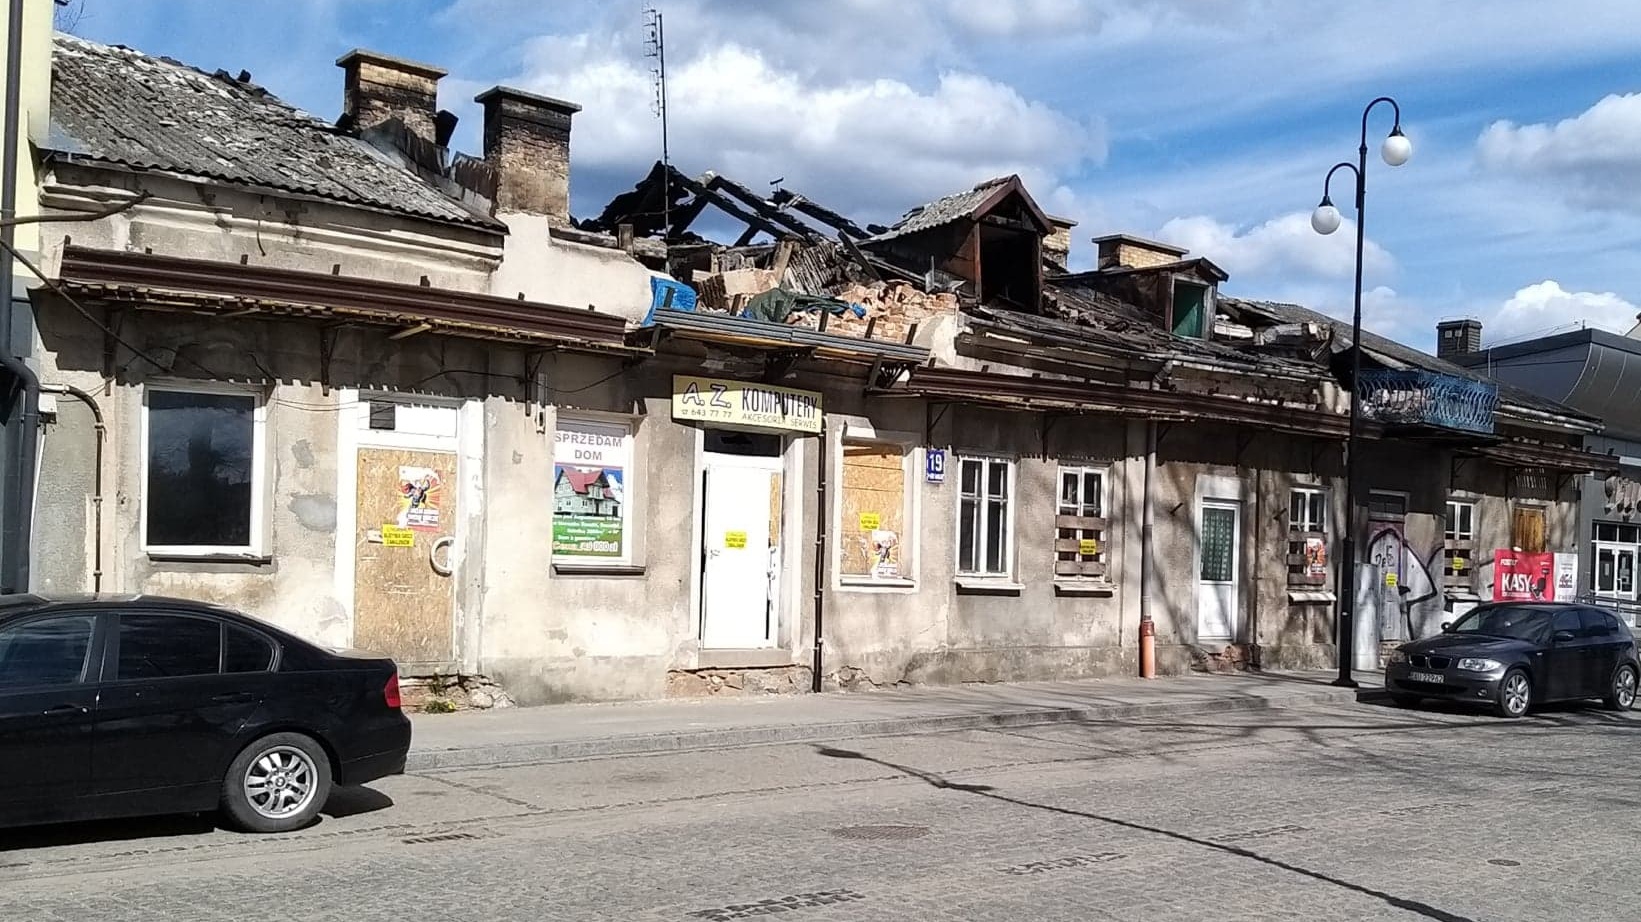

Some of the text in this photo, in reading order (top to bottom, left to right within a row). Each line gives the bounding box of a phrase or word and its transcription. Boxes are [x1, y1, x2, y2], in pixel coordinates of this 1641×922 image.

[742, 387, 818, 420] KOMPUTERY
[691, 409, 706, 417] 643
[722, 410, 732, 418] 77
[790, 418, 817, 429] SERWIS
[555, 433, 622, 448] SPRZEDAM
[574, 449, 602, 461] DOM
[929, 453, 943, 472] 19
[1501, 572, 1533, 592] KASY
